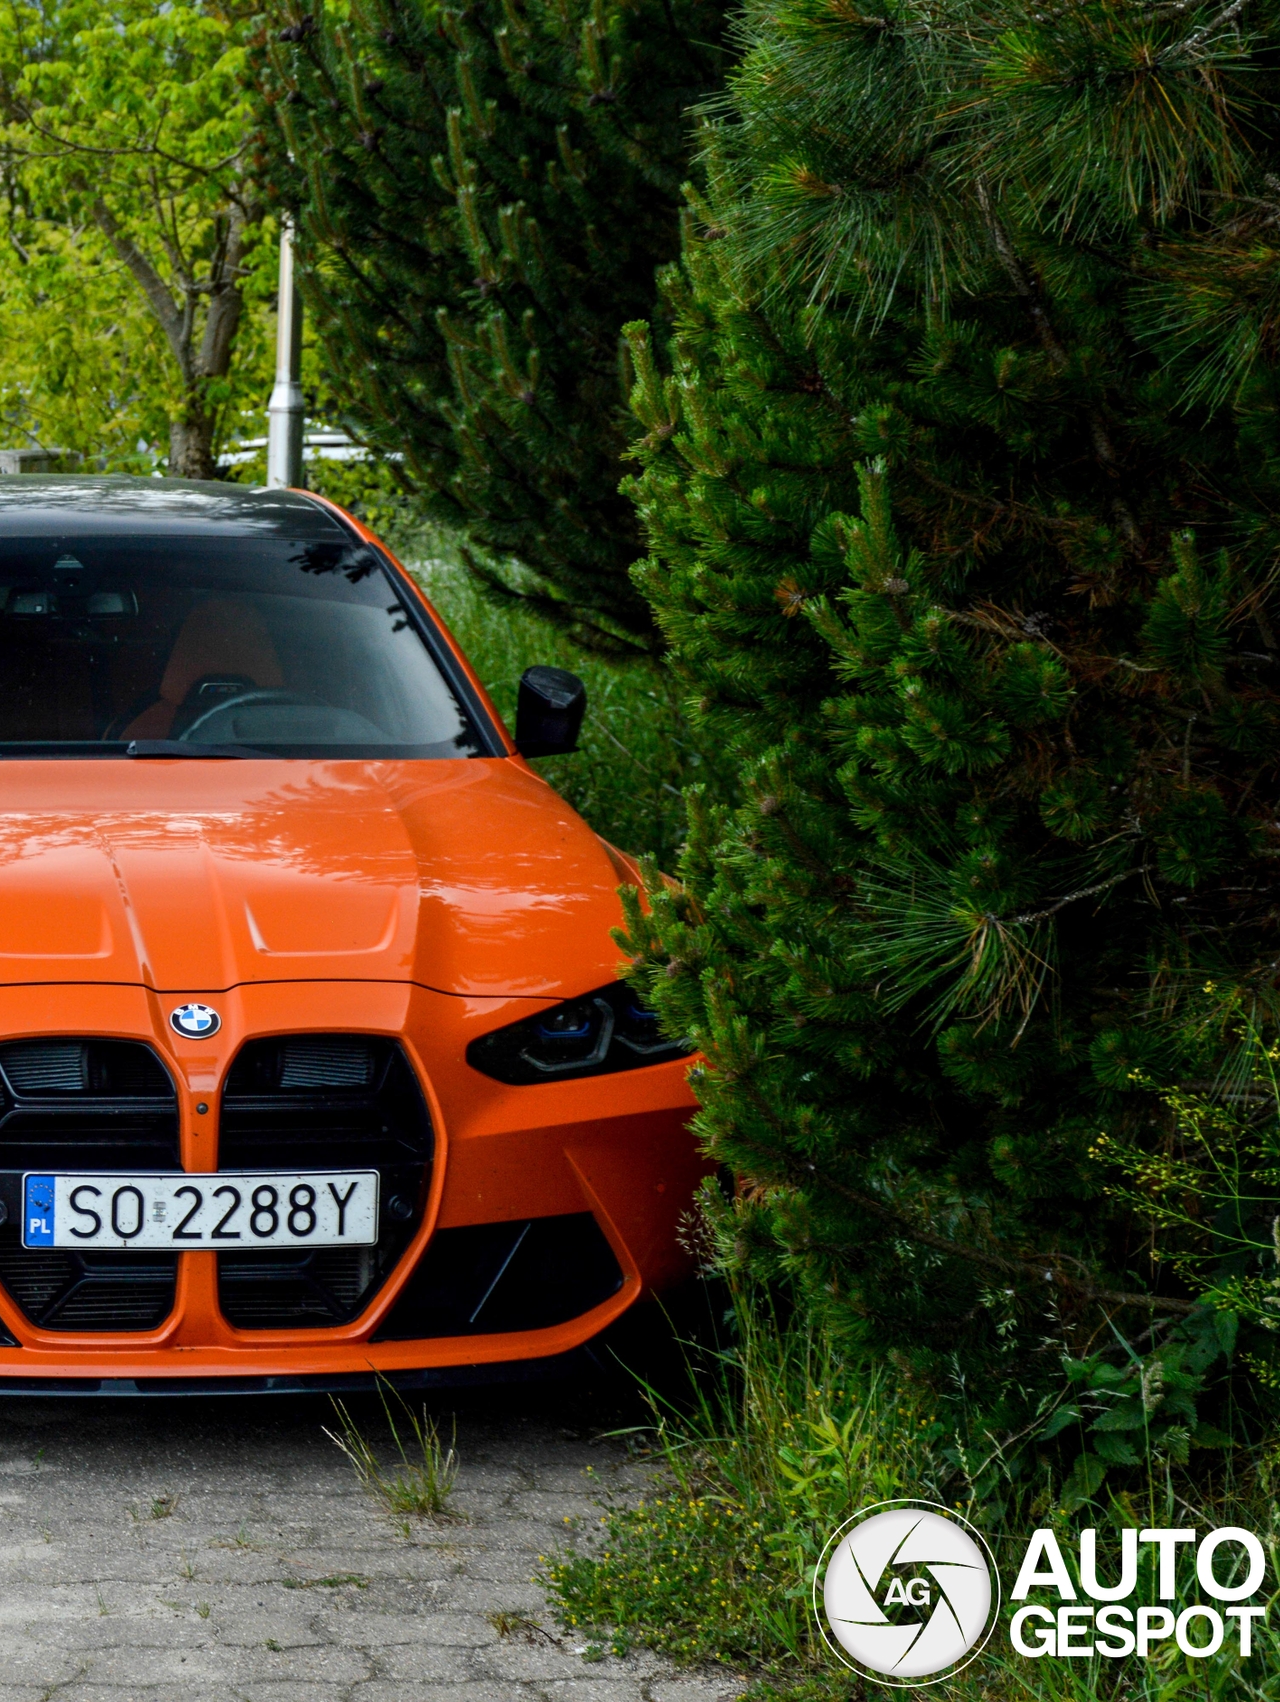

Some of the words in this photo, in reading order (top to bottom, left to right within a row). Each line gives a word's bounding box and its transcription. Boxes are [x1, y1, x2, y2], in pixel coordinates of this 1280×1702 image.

[29, 1218, 51, 1234] PL
[69, 1184, 145, 1240] SO
[172, 1181, 359, 1240] 2288Y
